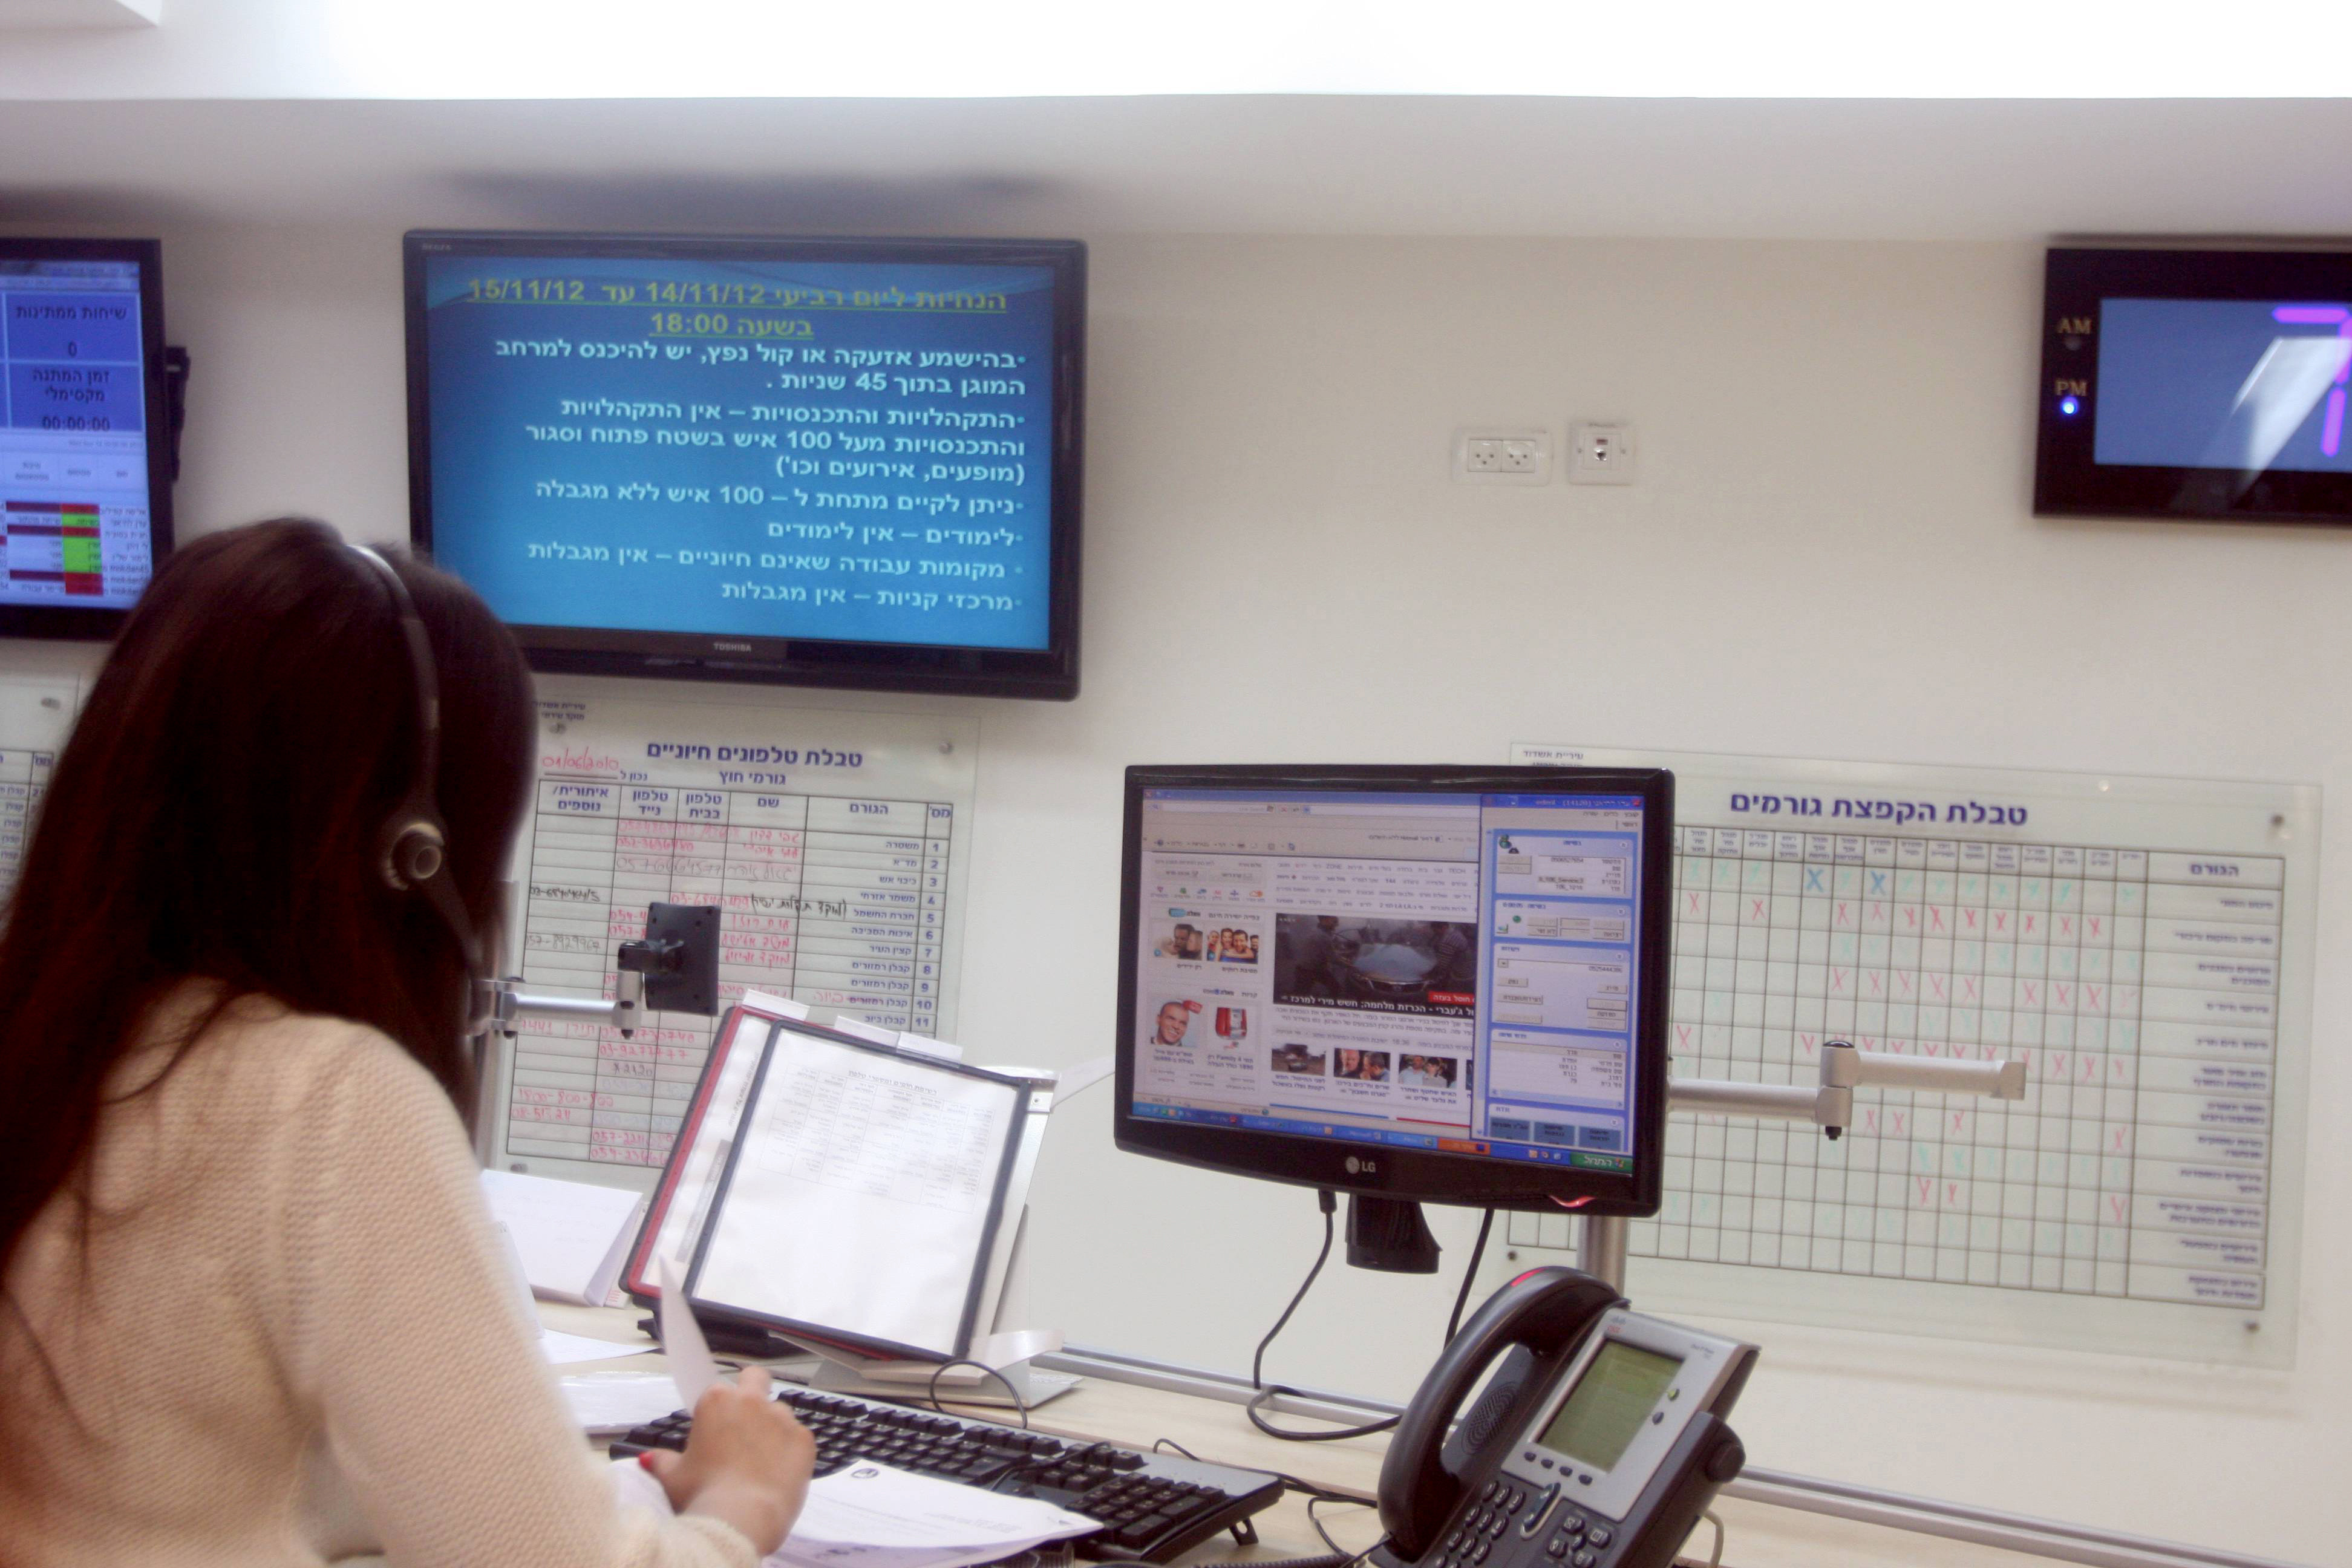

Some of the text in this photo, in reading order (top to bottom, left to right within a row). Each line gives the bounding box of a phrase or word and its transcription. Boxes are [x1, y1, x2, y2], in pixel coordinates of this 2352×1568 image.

[468, 278, 1007, 310] הנחיות ליום רביעי 14/11/12 עד 15/11/12
[16, 305, 127, 321] שיחות ממתינות
[651, 313, 813, 337] בשעה 18:00
[2058, 318, 2092, 335] AM
[495, 338, 572, 357] למרחב
[579, 339, 658, 359] להיכנס
[666, 343, 692, 360] יש
[700, 345, 748, 365] נפץ,
[756, 343, 794, 367] קול
[802, 347, 826, 364] או
[834, 348, 912, 370] אזעקה
[31, 368, 110, 385] זמן המתנה
[781, 372, 1026, 399] המוגן בתוך 45 שניות
[2054, 380, 2088, 397] PM
[44, 387, 105, 404] מקסימלי
[560, 397, 682, 421] התקהלויות
[690, 404, 721, 423] אין
[751, 405, 878, 425] והתכנסויות
[525, 425, 1025, 456] והתכנסויות מעל 100 איש בשטח פתוח וסגור
[775, 457, 1025, 486] (מופעים, אירועים וכו')
[536, 479, 1015, 517] ניתן לקיים מתחת ל 100 איש ללא מגבלה
[767, 521, 1015, 546] לימודים אין לימודים
[528, 541, 1005, 581] מקומות עבודה שאינם חיוניים אין מגבלות
[721, 581, 1014, 612] מרכזי קניות אין מגבלות
[713, 642, 753, 652] TOSHIBA
[647, 742, 863, 768] טבלת טלפונים חיוניים
[1523, 748, 1584, 762] עיריית אשדוד
[718, 768, 786, 786] גורמי חוץ
[632, 789, 669, 803] טלפון
[685, 792, 722, 807] טלפון
[757, 797, 780, 809] שם
[557, 799, 601, 813] נוספים
[638, 804, 661, 818] נייד
[688, 807, 720, 820] בבית
[849, 803, 889, 815] הגורם
[929, 806, 952, 819] מס'
[1730, 792, 2027, 826] טבלת הקפצת גורמים
[930, 860, 938, 869] 2
[2189, 862, 2239, 877] הגורם
[929, 878, 938, 887] 3
[927, 913, 935, 923] 5
[926, 930, 933, 940] 6
[893, 947, 912, 956] קצין
[925, 948, 932, 958] 7
[852, 961, 931, 975] 8 קבלן רמזורים
[851, 978, 929, 993] 9 קבלן רמזורים
[886, 998, 908, 1008] קבלן
[916, 999, 932, 1011] 10
[1290, 995, 1316, 1005] למרכז
[1397, 1004, 1426, 1013] הכרזת
[884, 1016, 906, 1025] קבלן
[915, 1018, 929, 1027] 11
[1361, 1161, 1376, 1173] LG
[1583, 1155, 1613, 1168] התחל
